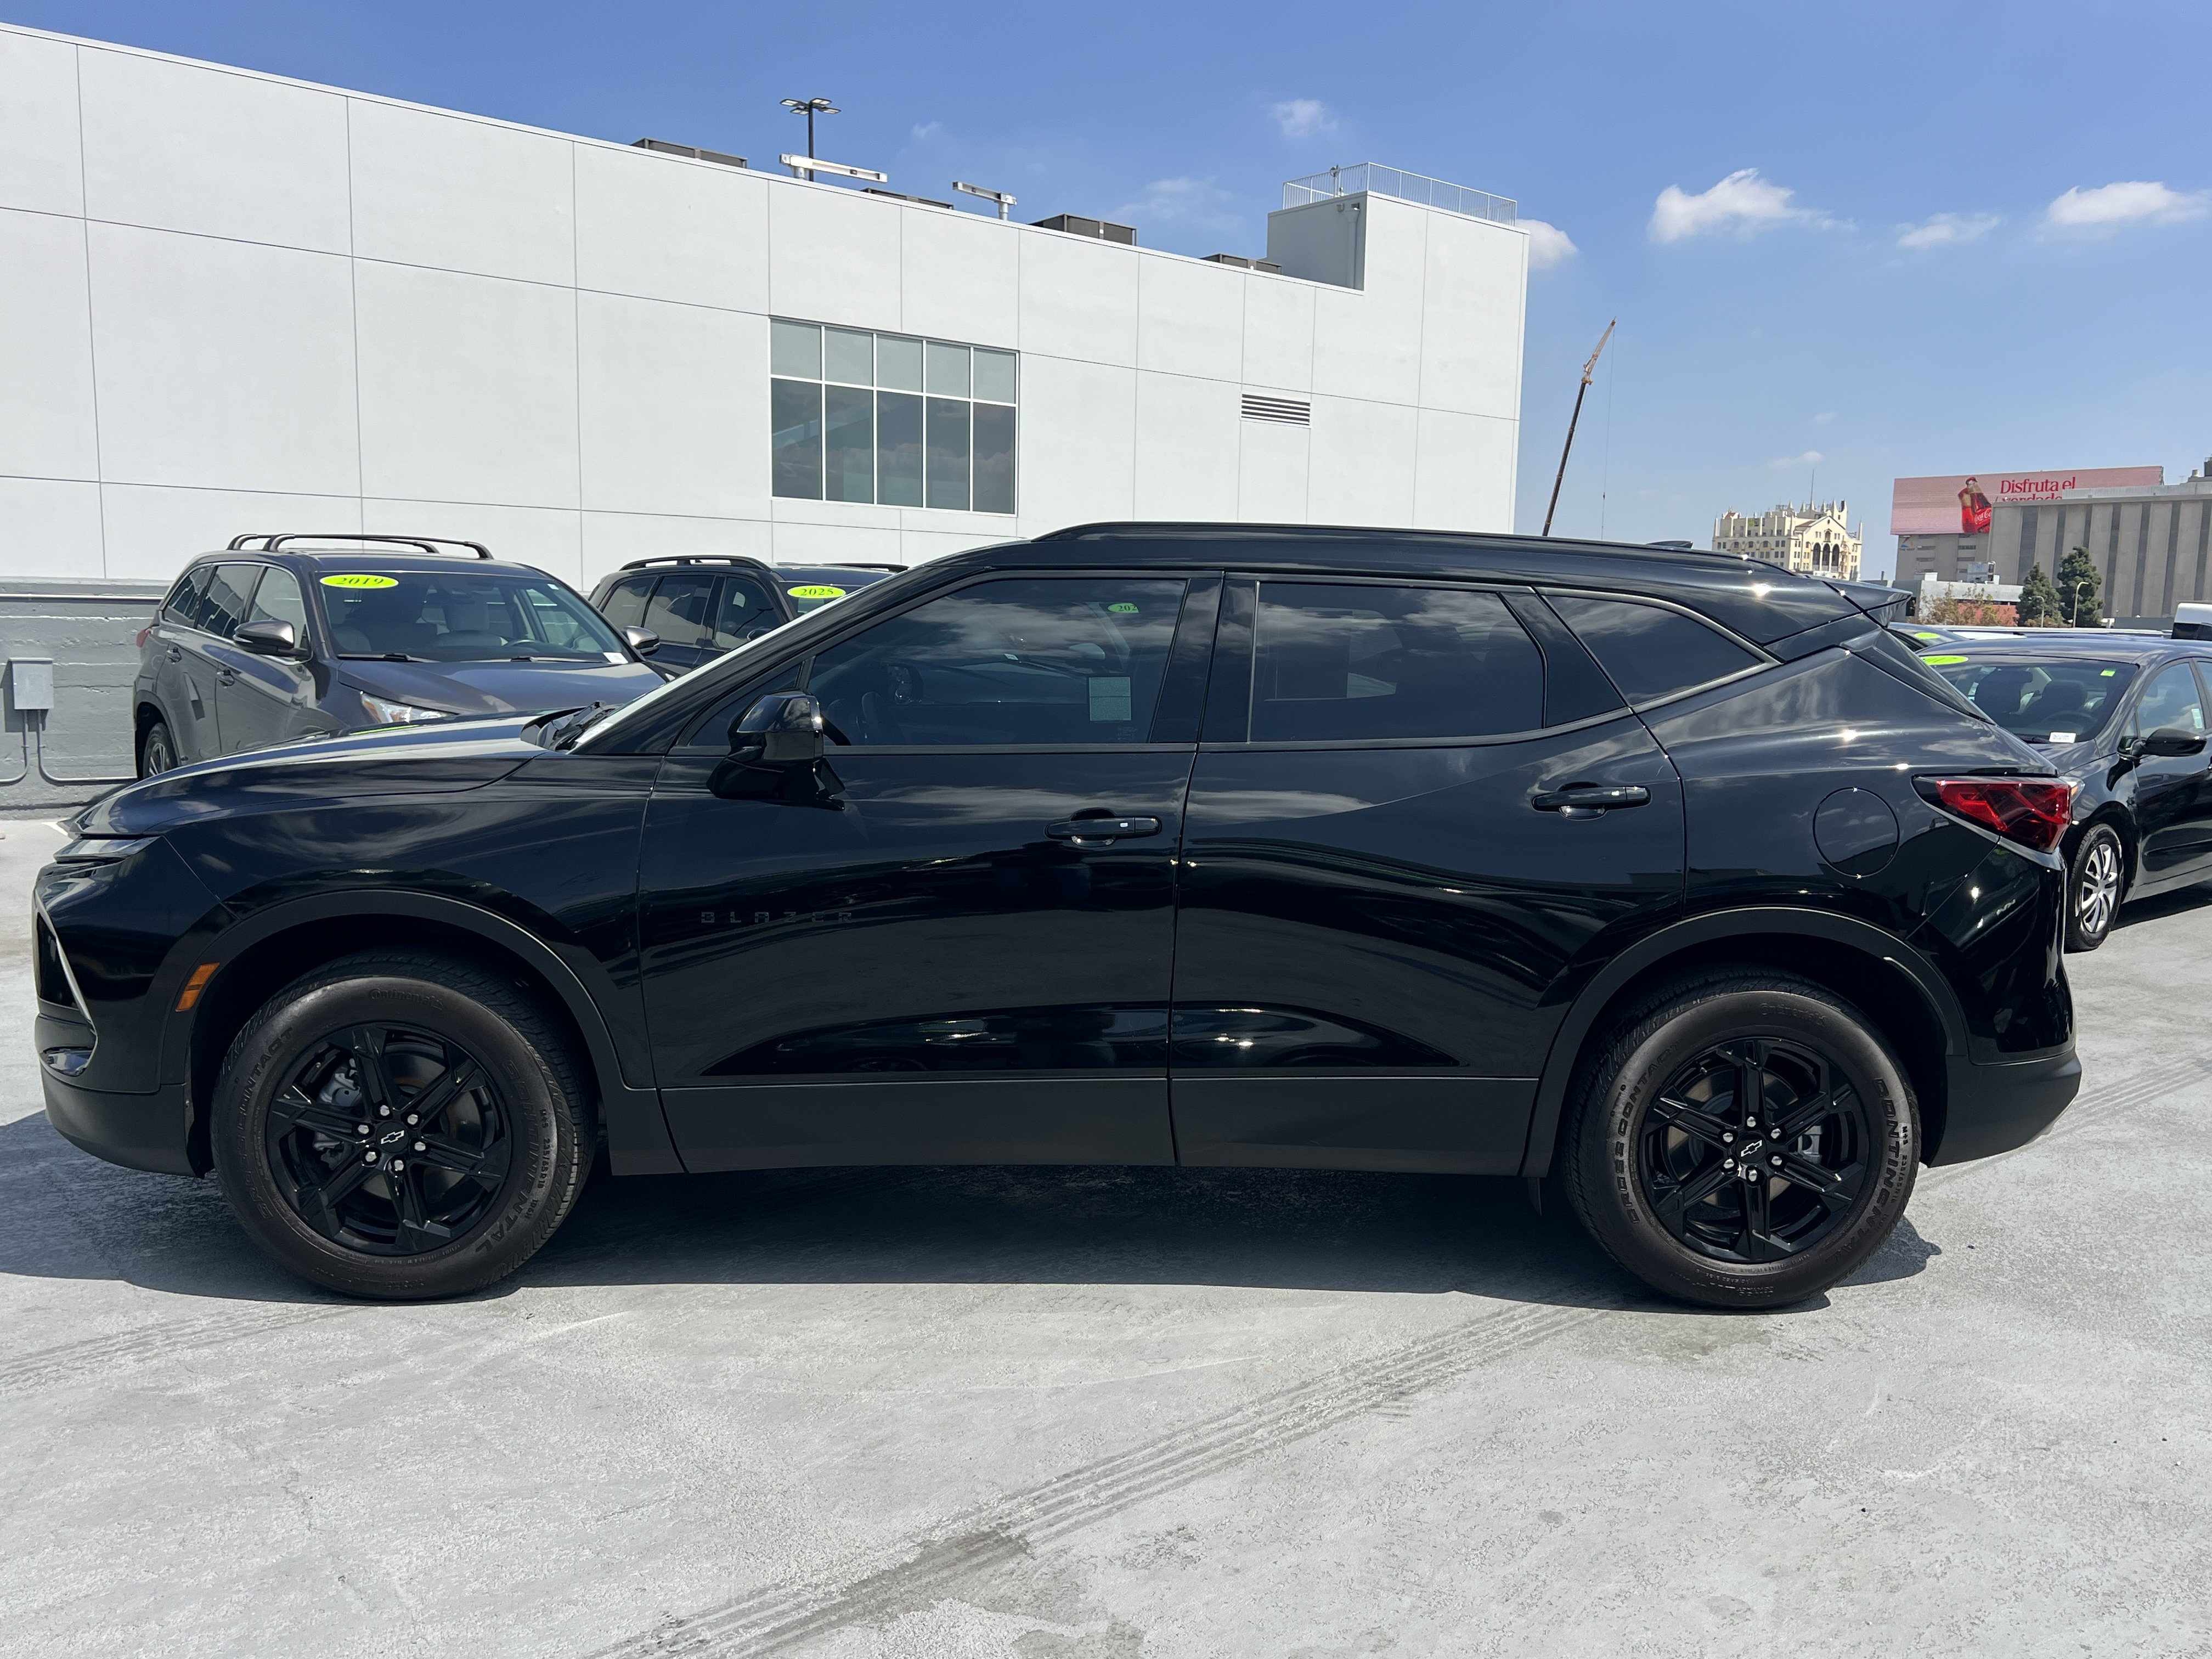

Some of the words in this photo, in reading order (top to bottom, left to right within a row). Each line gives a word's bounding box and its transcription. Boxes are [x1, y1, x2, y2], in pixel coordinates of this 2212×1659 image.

[2000, 478, 2058, 494] Disfruta
[2062, 476, 2076, 490] el
[800, 588, 834, 596] 2025
[701, 911, 853, 923] BLAZER
[237, 1026, 294, 1131] CONTACT
[1617, 1040, 1682, 1137] CONTACT
[475, 1059, 539, 1254] CONTINENTAL
[1615, 1140, 1640, 1224] CROSS
[1825, 1077, 1900, 1266] CONTINENTAL
